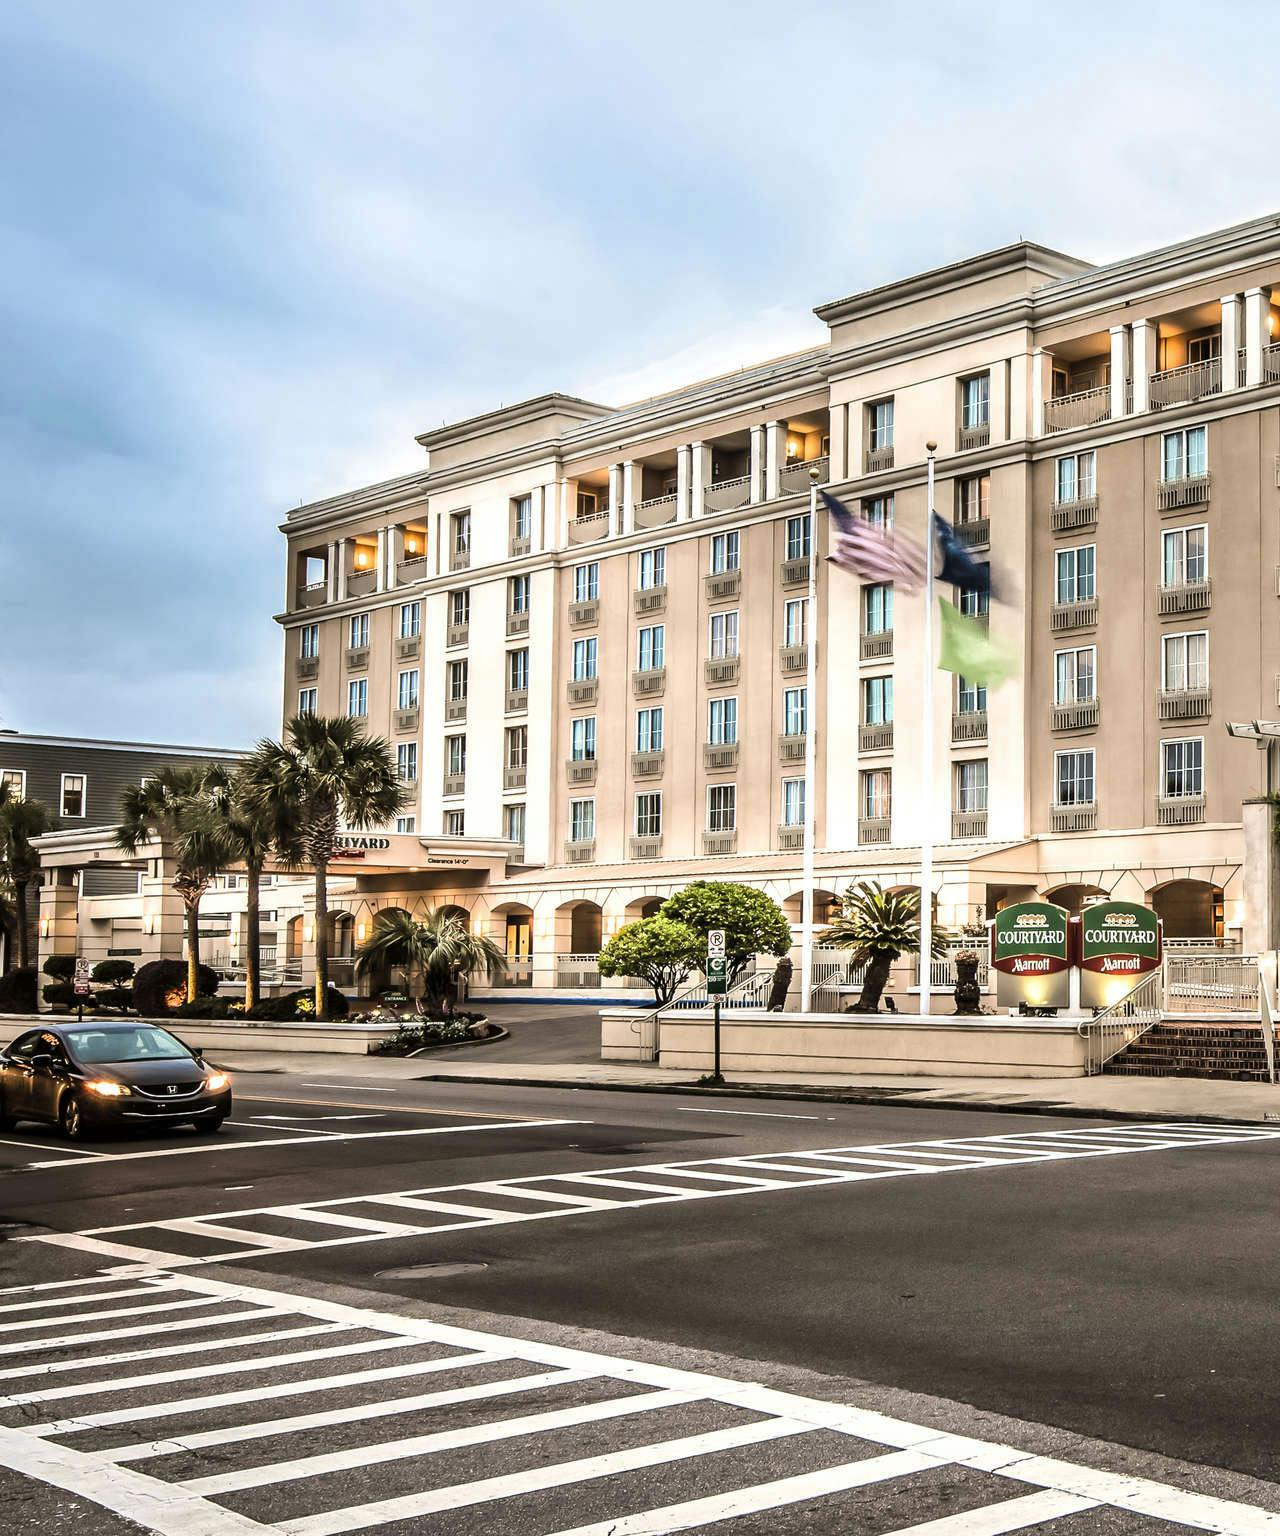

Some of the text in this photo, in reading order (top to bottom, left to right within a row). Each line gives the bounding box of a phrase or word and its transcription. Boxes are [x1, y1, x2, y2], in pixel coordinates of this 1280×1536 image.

[998, 930, 1065, 945] COURTYARD
[1085, 929, 1156, 944] COURTYARD
[1011, 958, 1050, 973] Marriott
[1100, 957, 1141, 973] Marriott
